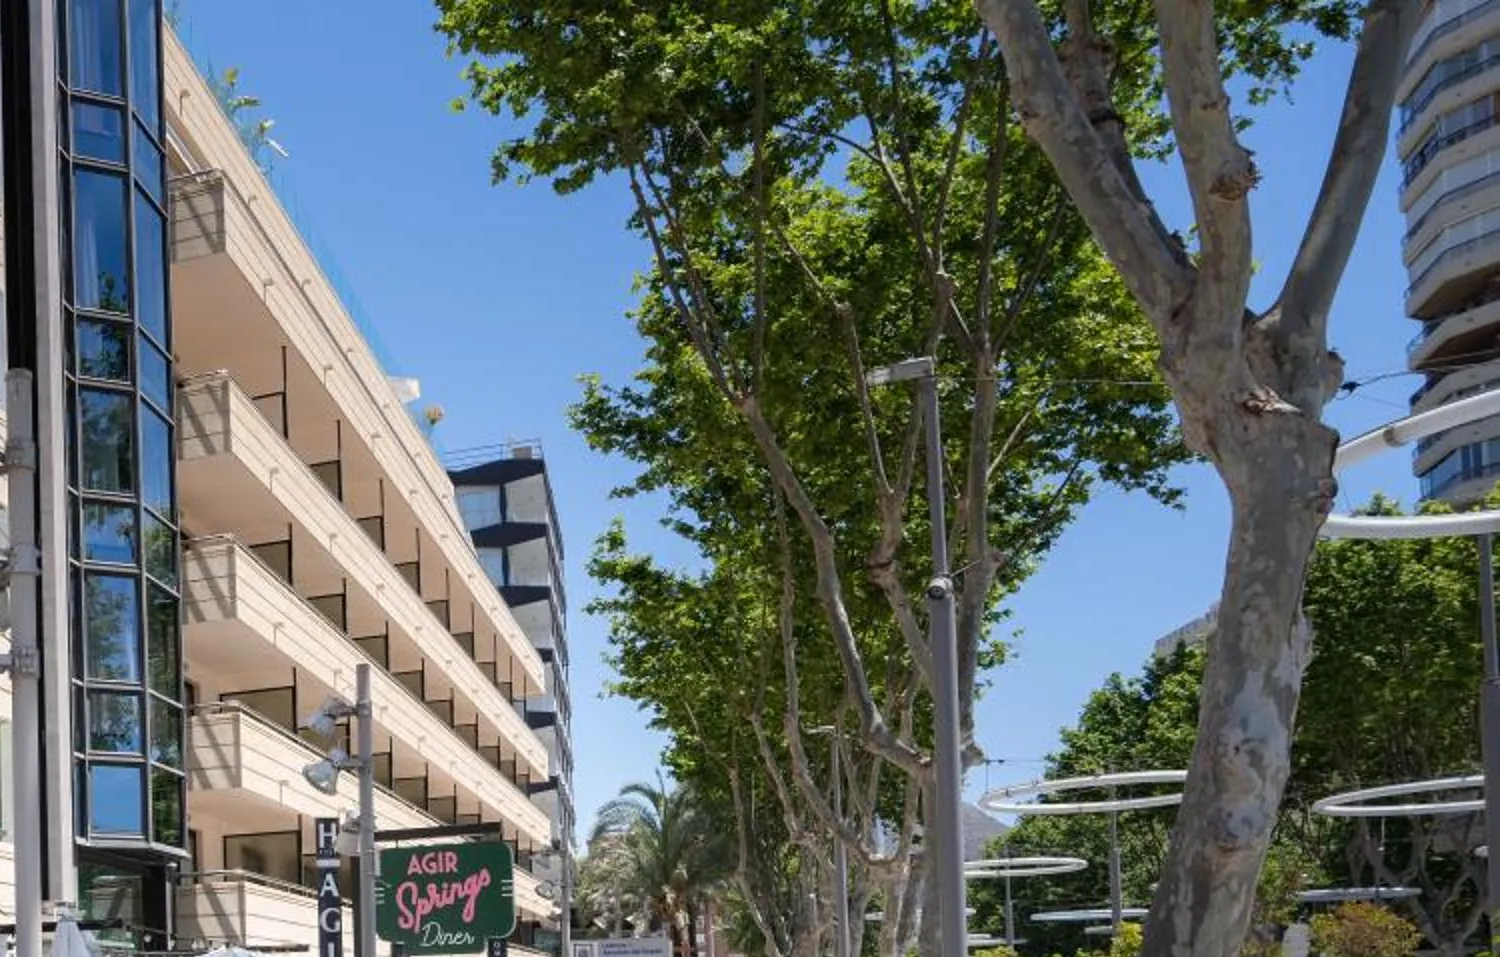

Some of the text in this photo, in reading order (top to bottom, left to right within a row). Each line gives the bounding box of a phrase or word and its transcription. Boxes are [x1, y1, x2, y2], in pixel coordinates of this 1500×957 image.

[407, 851, 458, 875] AGIR
[396, 868, 491, 934] Springs
[420, 921, 475, 947] Diner
